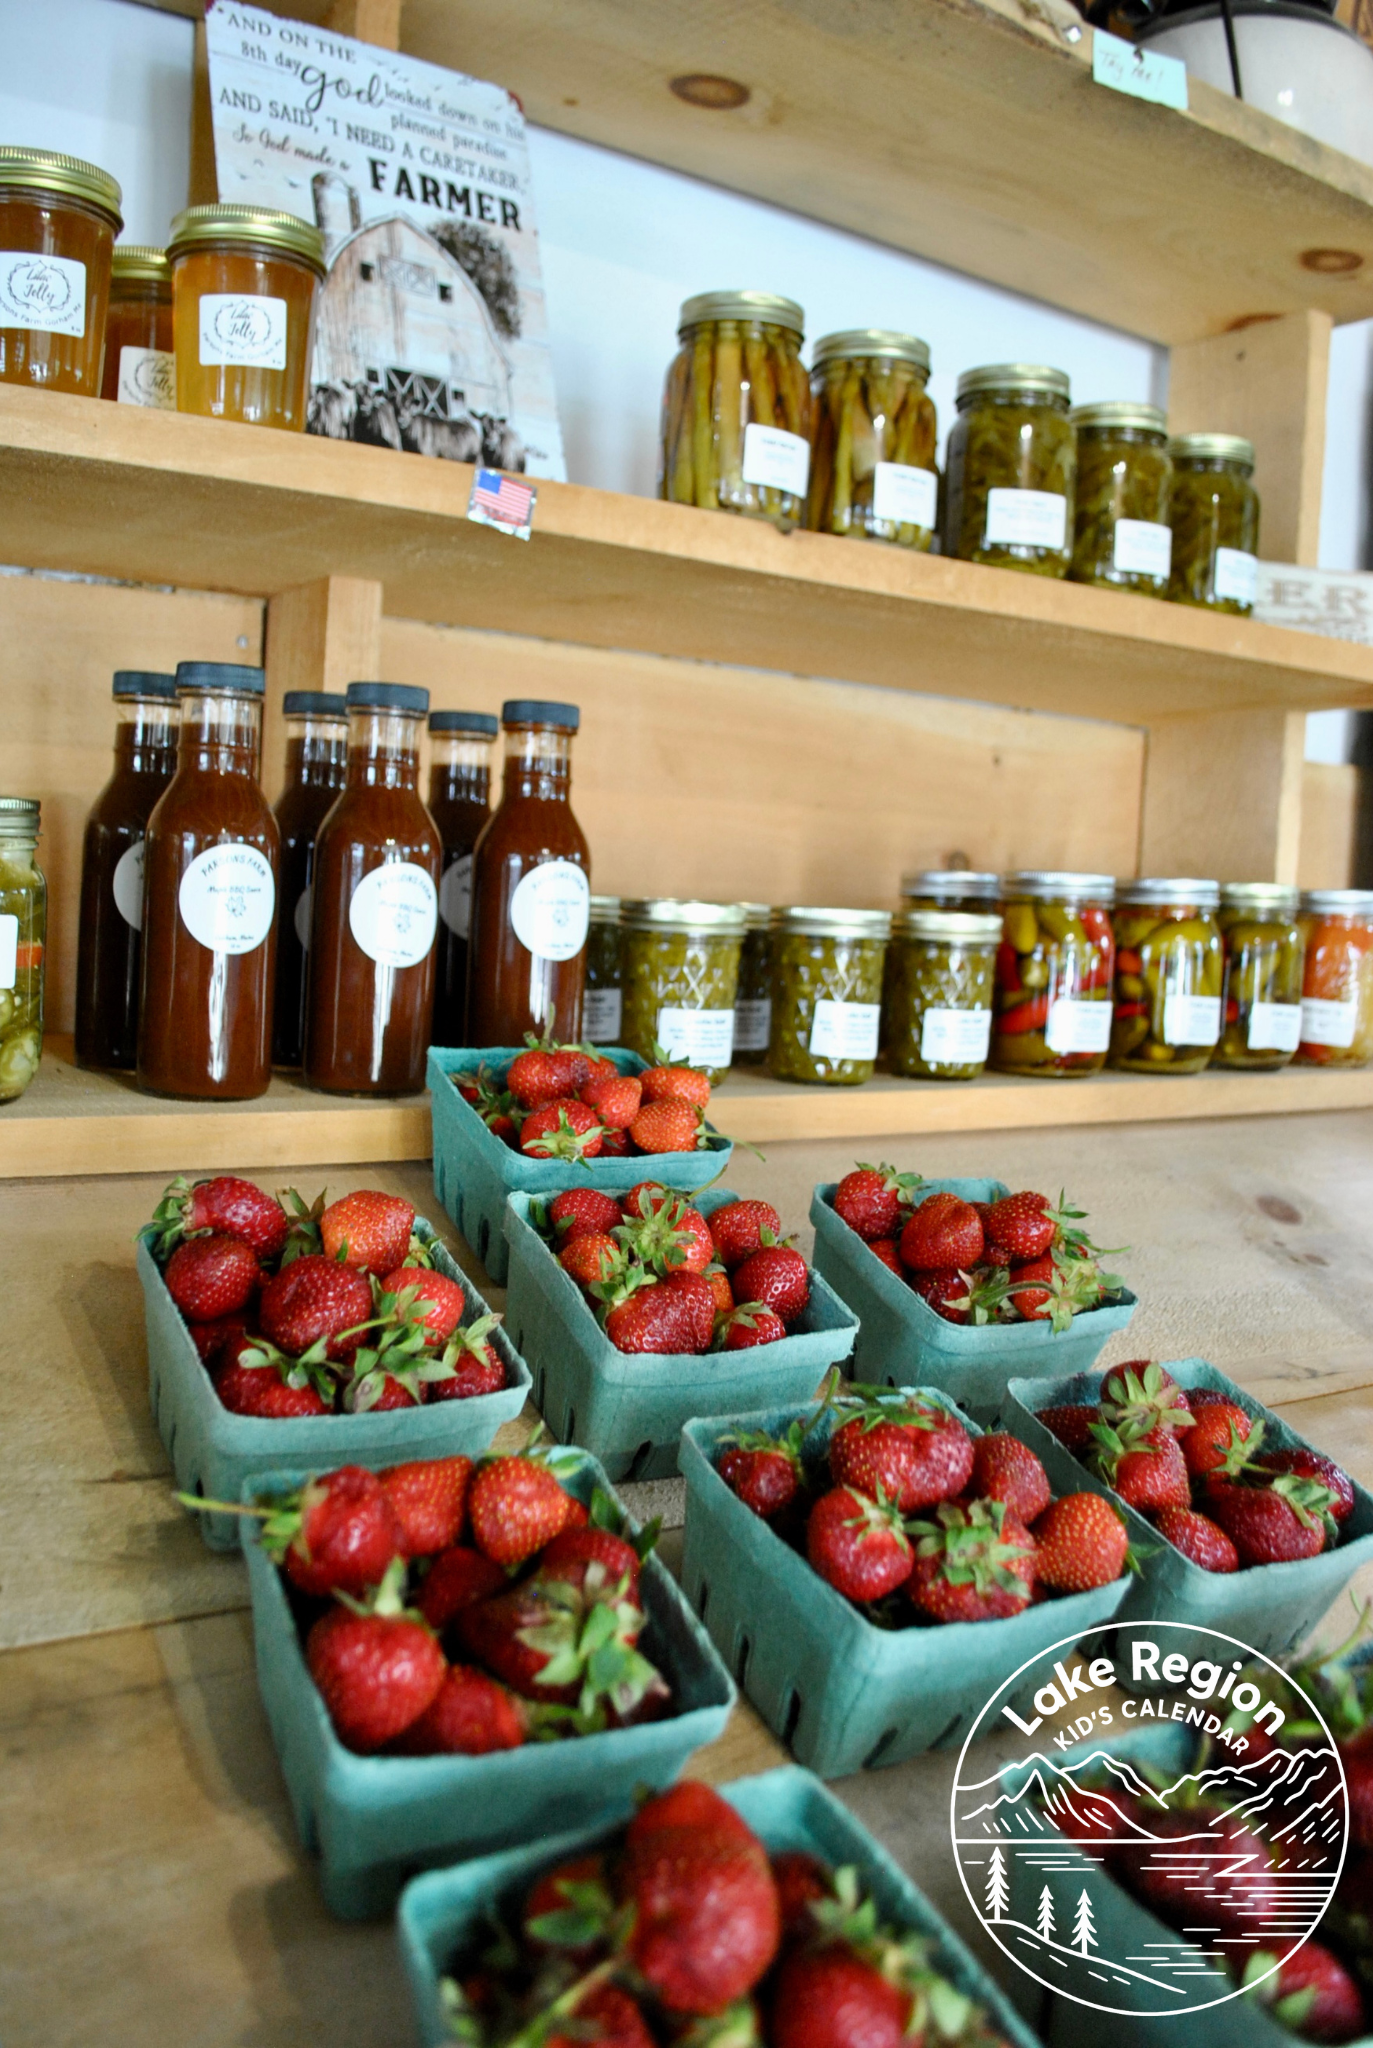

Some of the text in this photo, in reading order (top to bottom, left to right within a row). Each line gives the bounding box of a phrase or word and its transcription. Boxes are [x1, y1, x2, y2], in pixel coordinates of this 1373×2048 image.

[228, 13, 357, 64] AND ON THE
[241, 41, 267, 62] 8th
[275, 52, 302, 76] day
[385, 81, 432, 111] looked
[438, 101, 478, 126] down
[483, 119, 501, 133] on
[219, 87, 262, 113] AND
[268, 99, 320, 134] SAID,
[346, 122, 396, 153] NEED
[402, 140, 414, 160] A
[390, 113, 446, 141] planned
[232, 122, 255, 144] So
[259, 127, 292, 154] God
[294, 146, 337, 167] made
[367, 155, 522, 233] FARMER
[23, 282, 55, 306] Jelly
[20, 314, 42, 326] Farm
[45, 311, 74, 326] Gorham
[228, 320, 256, 343] Jelly
